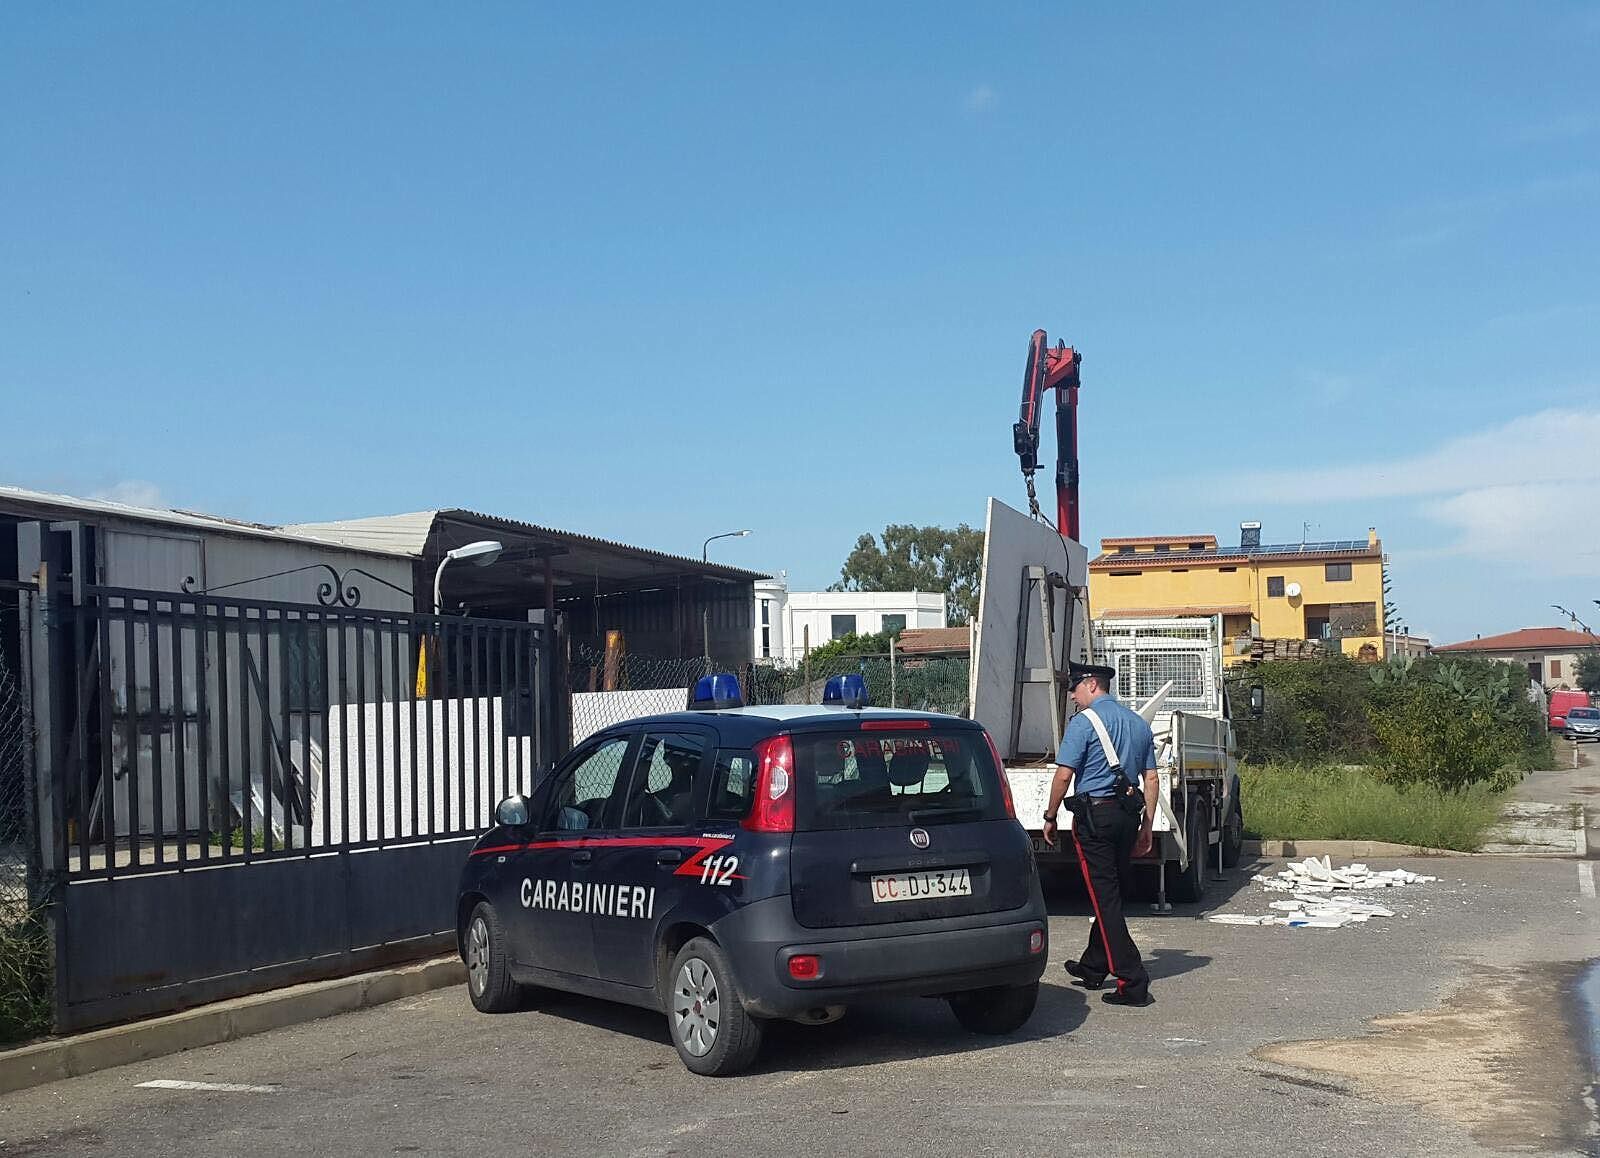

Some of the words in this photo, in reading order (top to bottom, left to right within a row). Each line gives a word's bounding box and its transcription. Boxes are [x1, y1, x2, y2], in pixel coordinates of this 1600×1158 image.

[700, 855, 739, 886] 112
[875, 877, 898, 899] CC
[908, 874, 930, 896] DJ
[936, 870, 968, 894] 344
[520, 877, 655, 919] CARABINIERI
